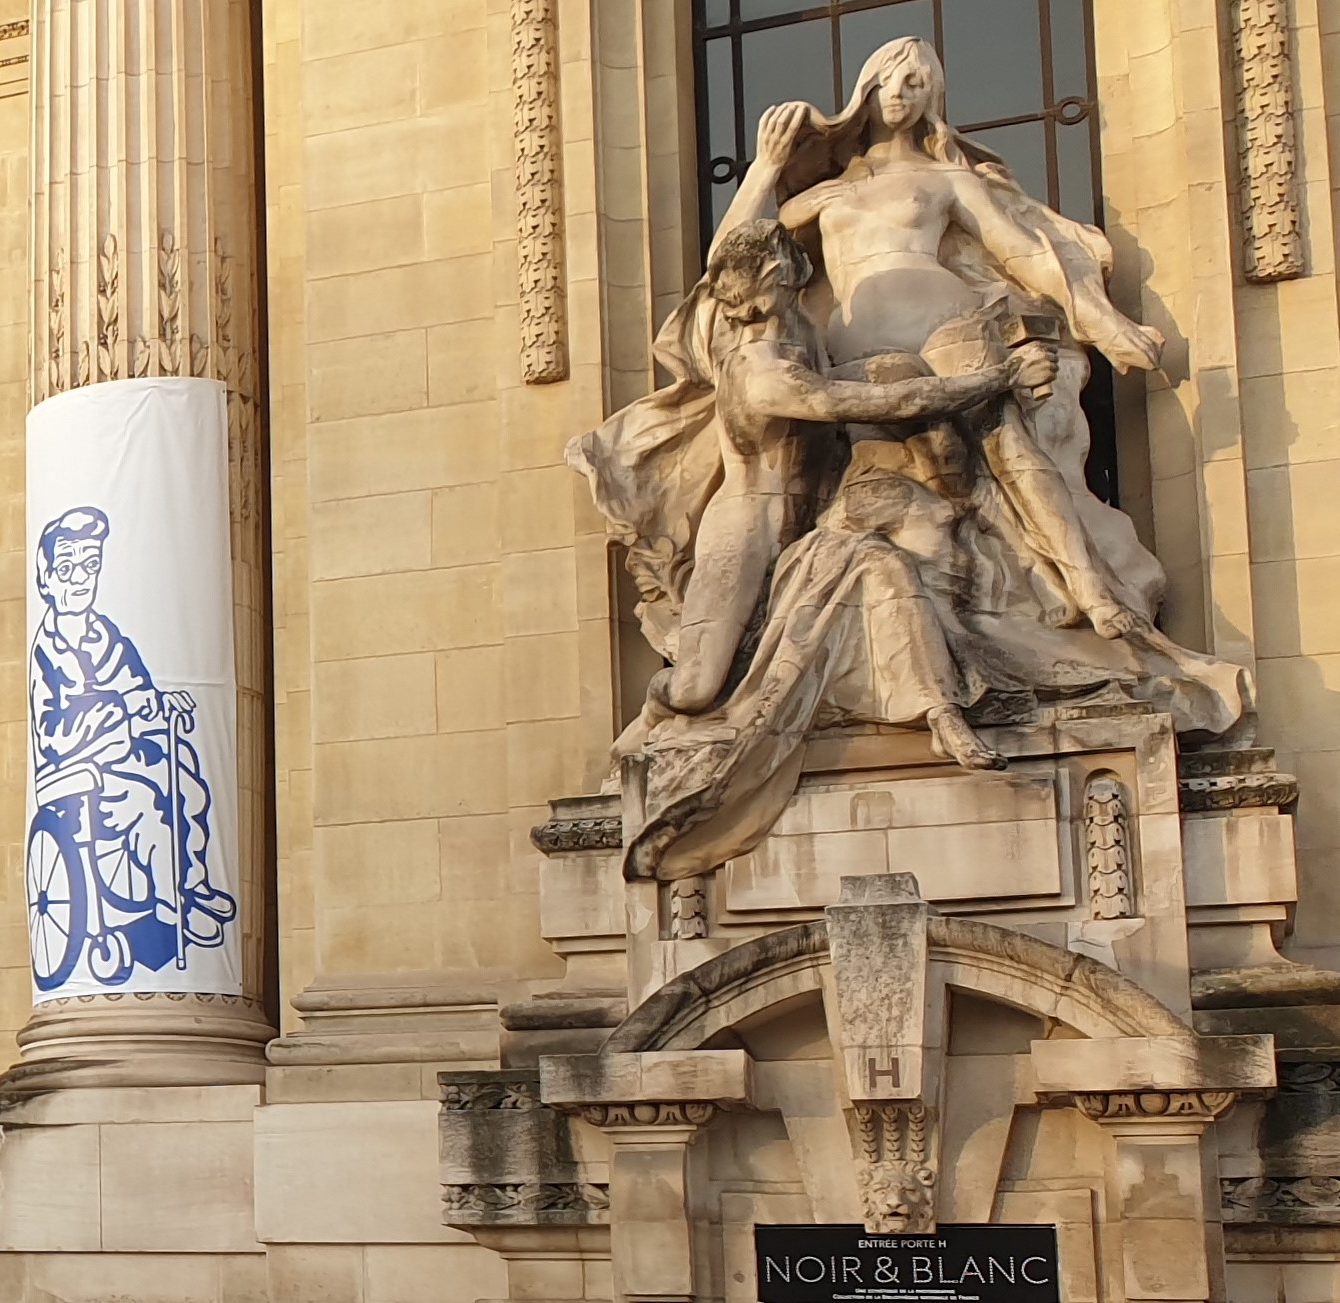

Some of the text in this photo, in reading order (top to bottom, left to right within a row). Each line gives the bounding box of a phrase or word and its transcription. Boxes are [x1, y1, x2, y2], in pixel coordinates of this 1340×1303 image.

[868, 1057, 900, 1088] H
[858, 1238, 947, 1249] ENTRÉE PORTE H
[765, 1256, 1049, 1284] NOIR & BLANC
